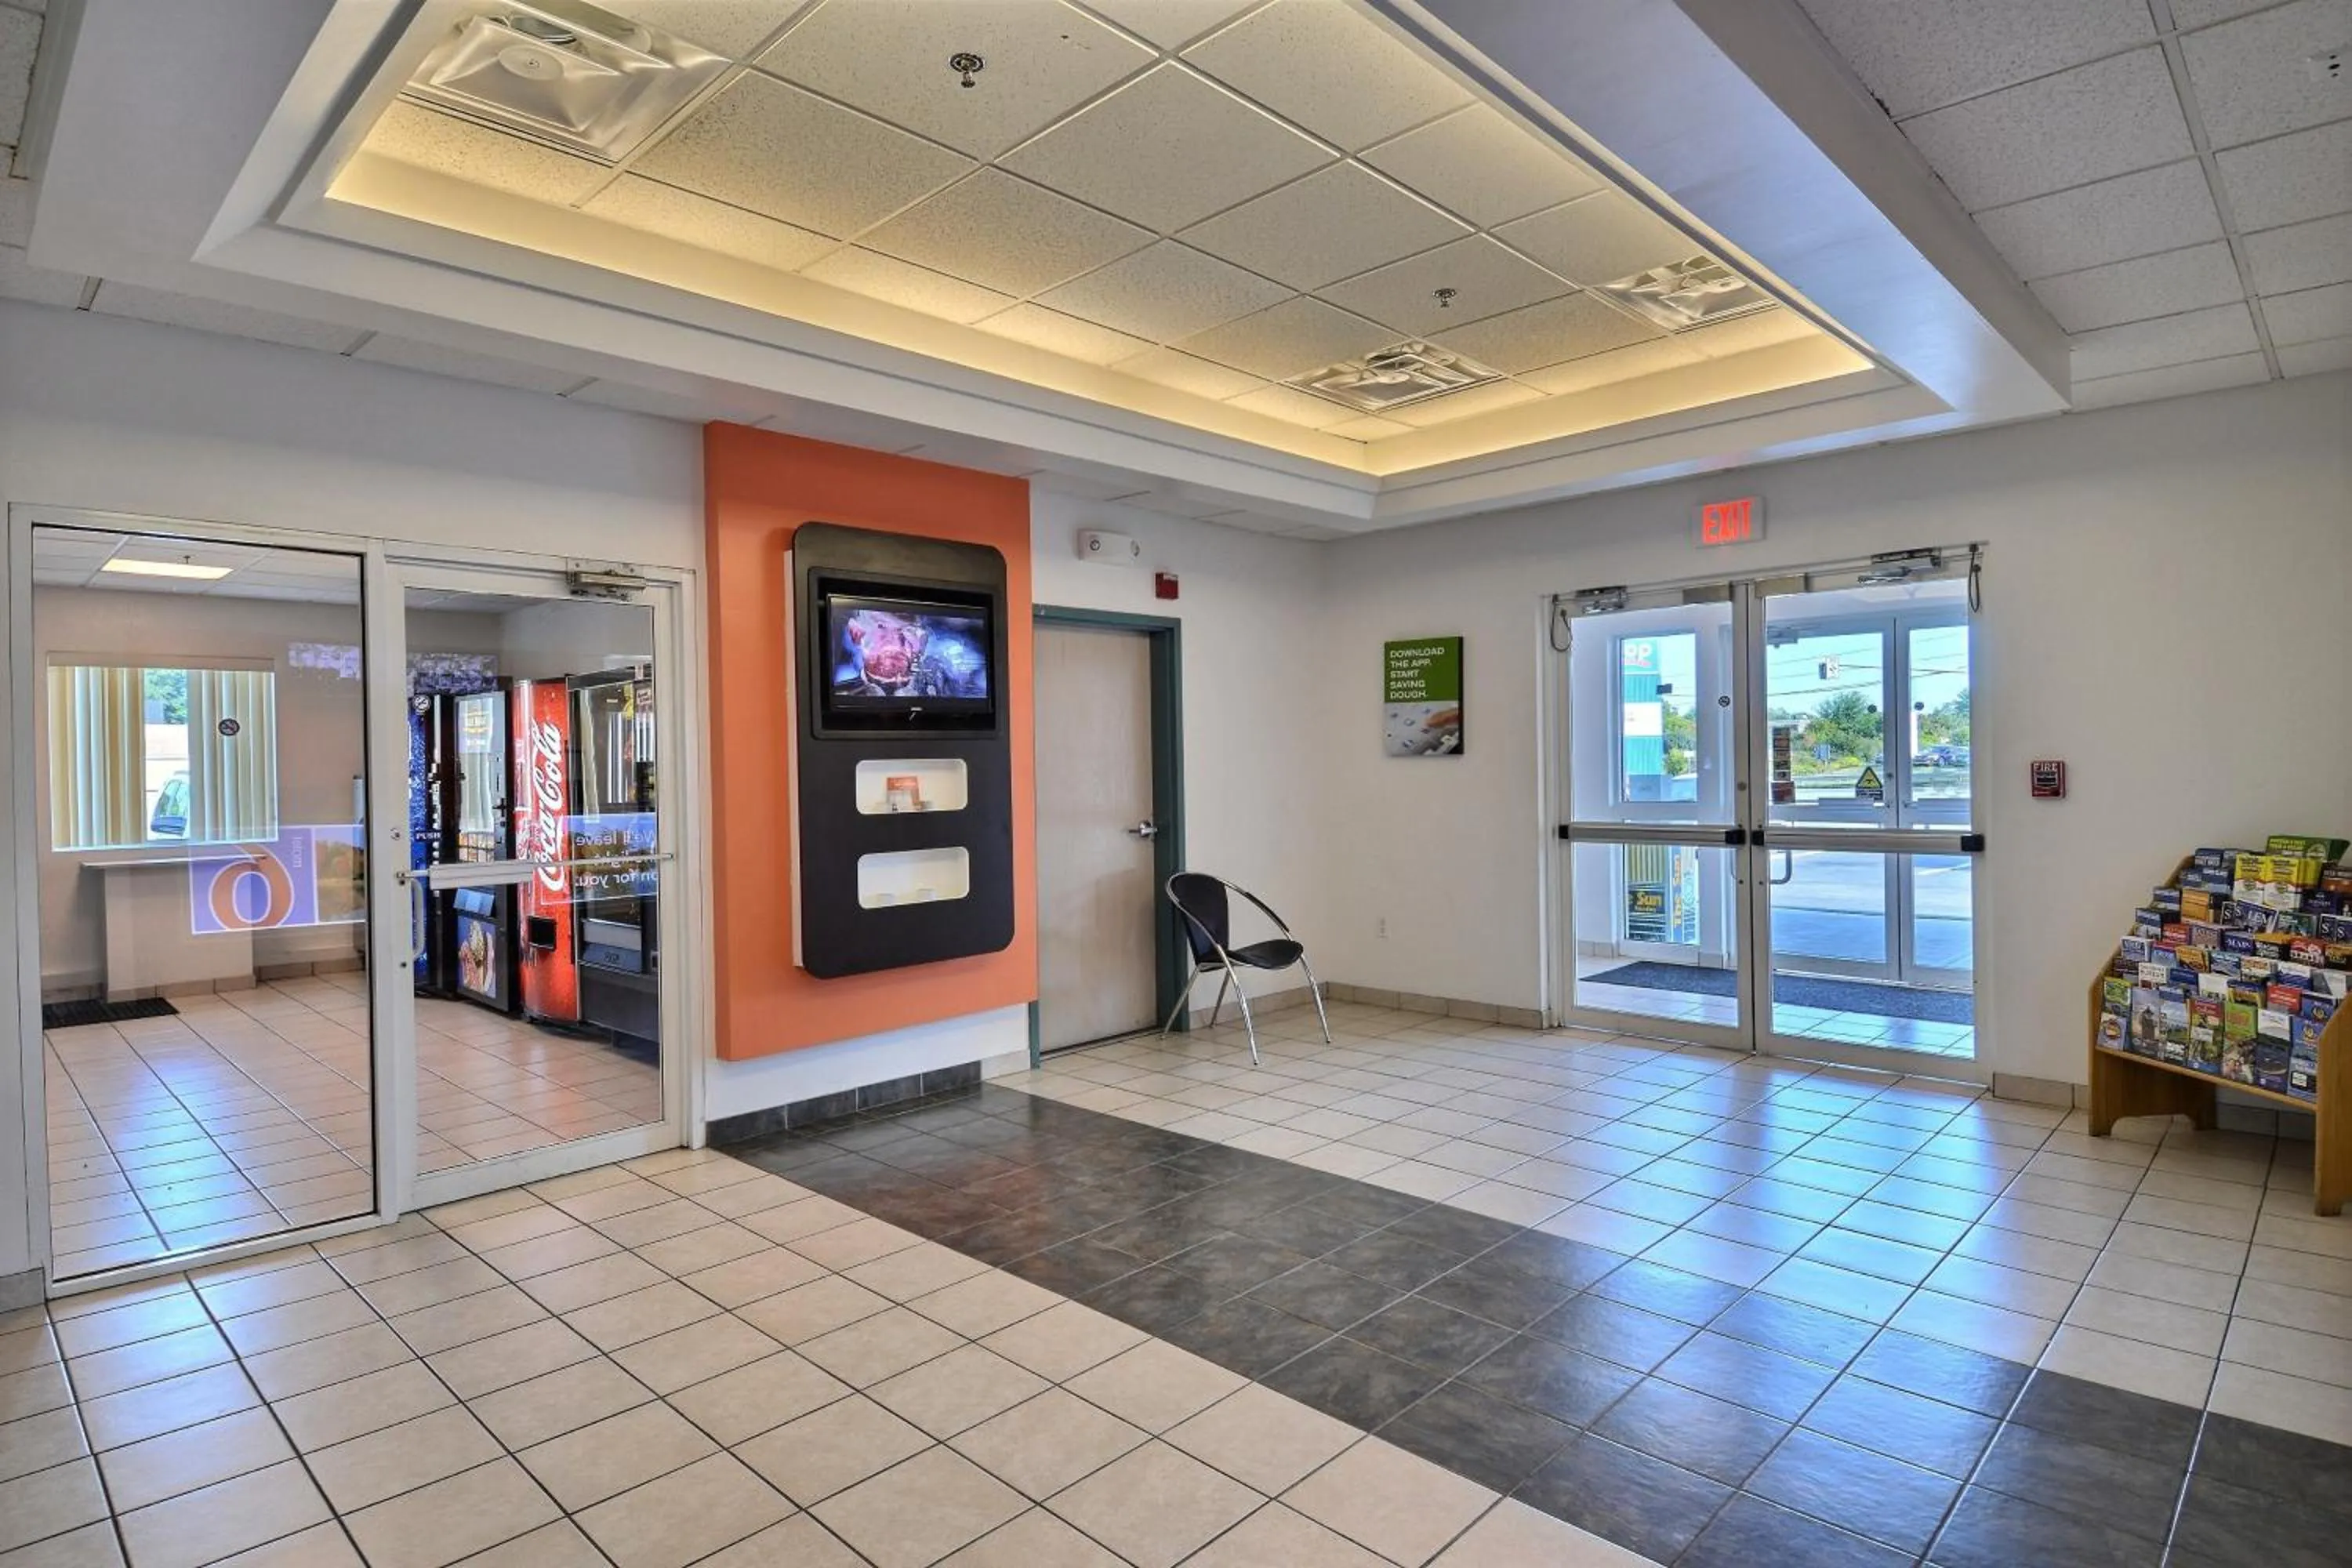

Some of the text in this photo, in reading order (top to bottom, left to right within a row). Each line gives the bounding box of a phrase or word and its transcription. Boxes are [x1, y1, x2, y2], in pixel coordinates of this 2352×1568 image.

[1703, 502, 1751, 543] EXIT
[1390, 647, 1445, 659] DOWNLOAD
[1390, 670, 1420, 679] START
[1390, 680, 1426, 689] SAVING
[2034, 763, 2058, 771] FIRE
[2235, 908, 2273, 925] SLEM
